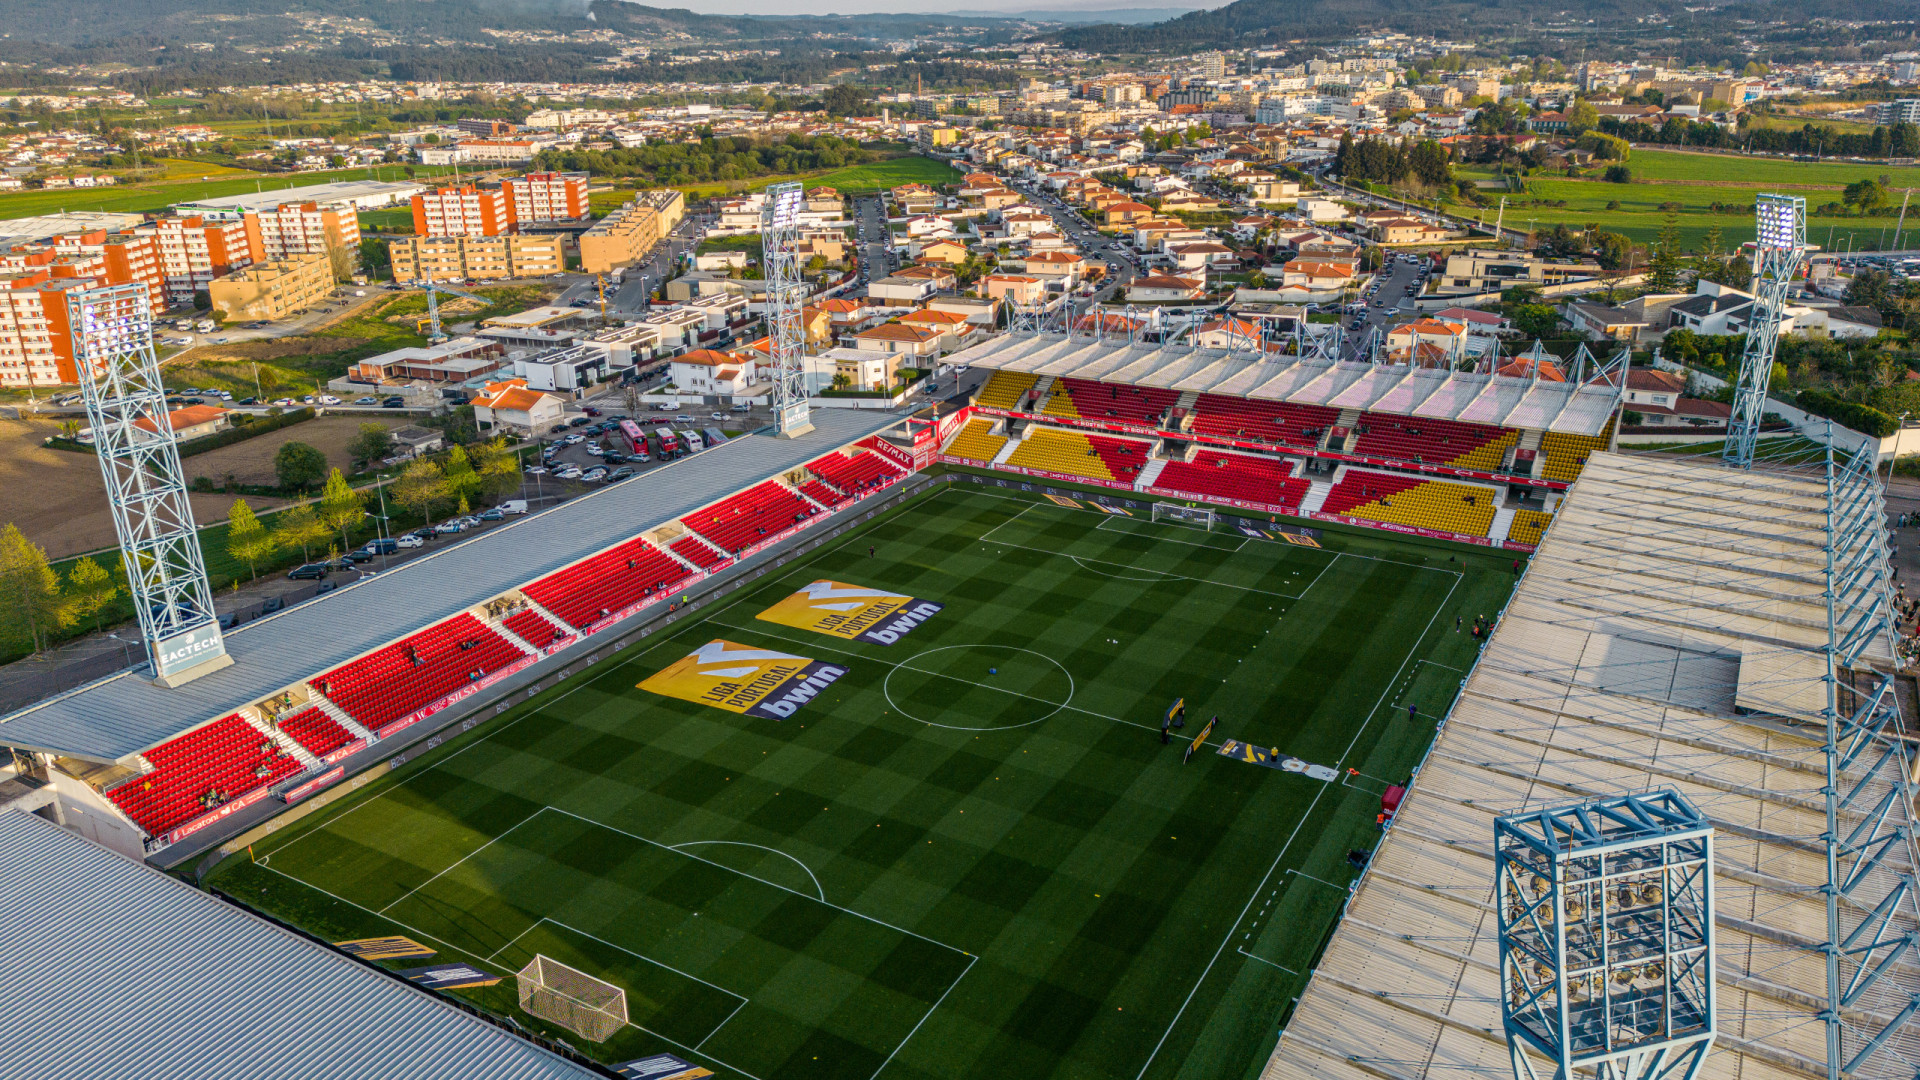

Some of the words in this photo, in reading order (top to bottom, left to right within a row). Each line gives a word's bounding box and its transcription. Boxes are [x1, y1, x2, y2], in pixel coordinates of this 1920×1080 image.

[877, 439, 911, 464] RE/MAX
[1269, 523, 1282, 531] B24
[1301, 528, 1313, 536] B24
[813, 614, 850, 631] LIGA
[835, 601, 898, 635] PORTUGAL
[866, 602, 943, 645] bwin
[161, 636, 218, 664] EACTECH
[558, 668, 570, 680] B24
[528, 684, 540, 696] B24
[701, 681, 744, 702] LIGA
[725, 665, 798, 708] PORTUGAL
[759, 665, 845, 718] bwin
[448, 686, 478, 704] SILSA
[496, 701, 510, 714] B24
[462, 717, 477, 731] B24
[427, 736, 442, 750] B24
[336, 750, 349, 760] CA
[391, 754, 406, 769] B24
[352, 776, 368, 790] B24
[231, 800, 246, 812] CA
[310, 797, 327, 811] B24
[181, 814, 219, 837] Lacatoni
[266, 819, 284, 834] B24
